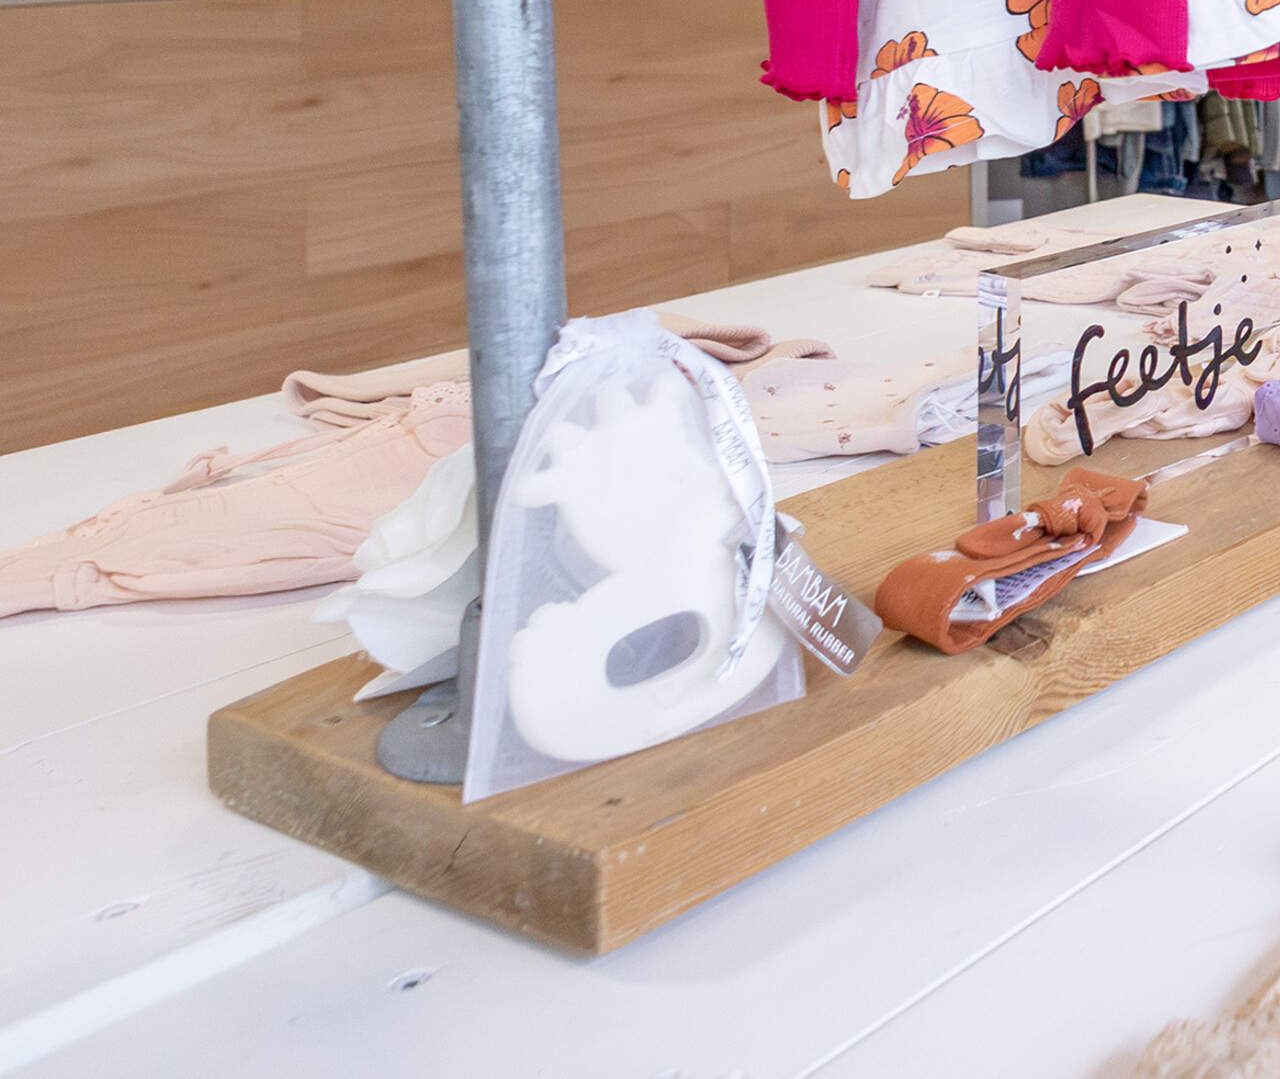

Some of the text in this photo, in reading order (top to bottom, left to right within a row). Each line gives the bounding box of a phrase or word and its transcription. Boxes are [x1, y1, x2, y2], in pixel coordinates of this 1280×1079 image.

[1067, 300, 1263, 457] feetje
[775, 541, 848, 628] BAMBAM
[809, 620, 856, 665] RUBBER
